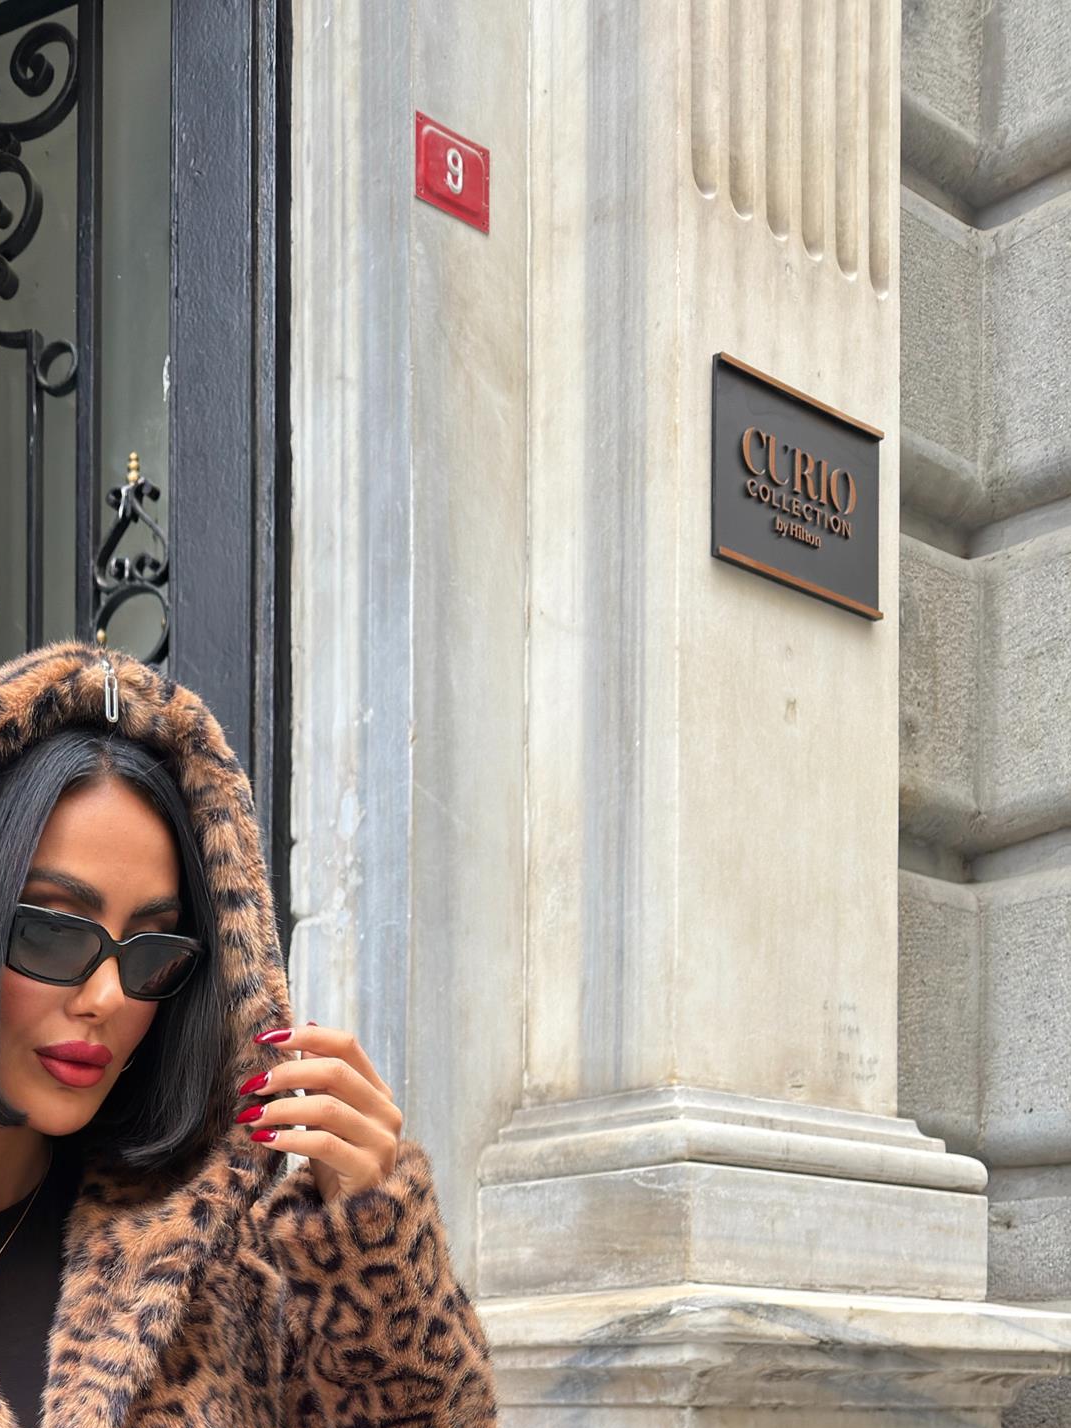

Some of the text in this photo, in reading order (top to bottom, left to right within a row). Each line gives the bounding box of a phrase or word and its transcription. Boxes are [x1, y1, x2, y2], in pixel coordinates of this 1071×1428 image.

[447, 148, 463, 194] 9
[742, 426, 857, 515] CURIO
[746, 479, 851, 538] COLLECTION
[776, 515, 822, 548] by Hilton
